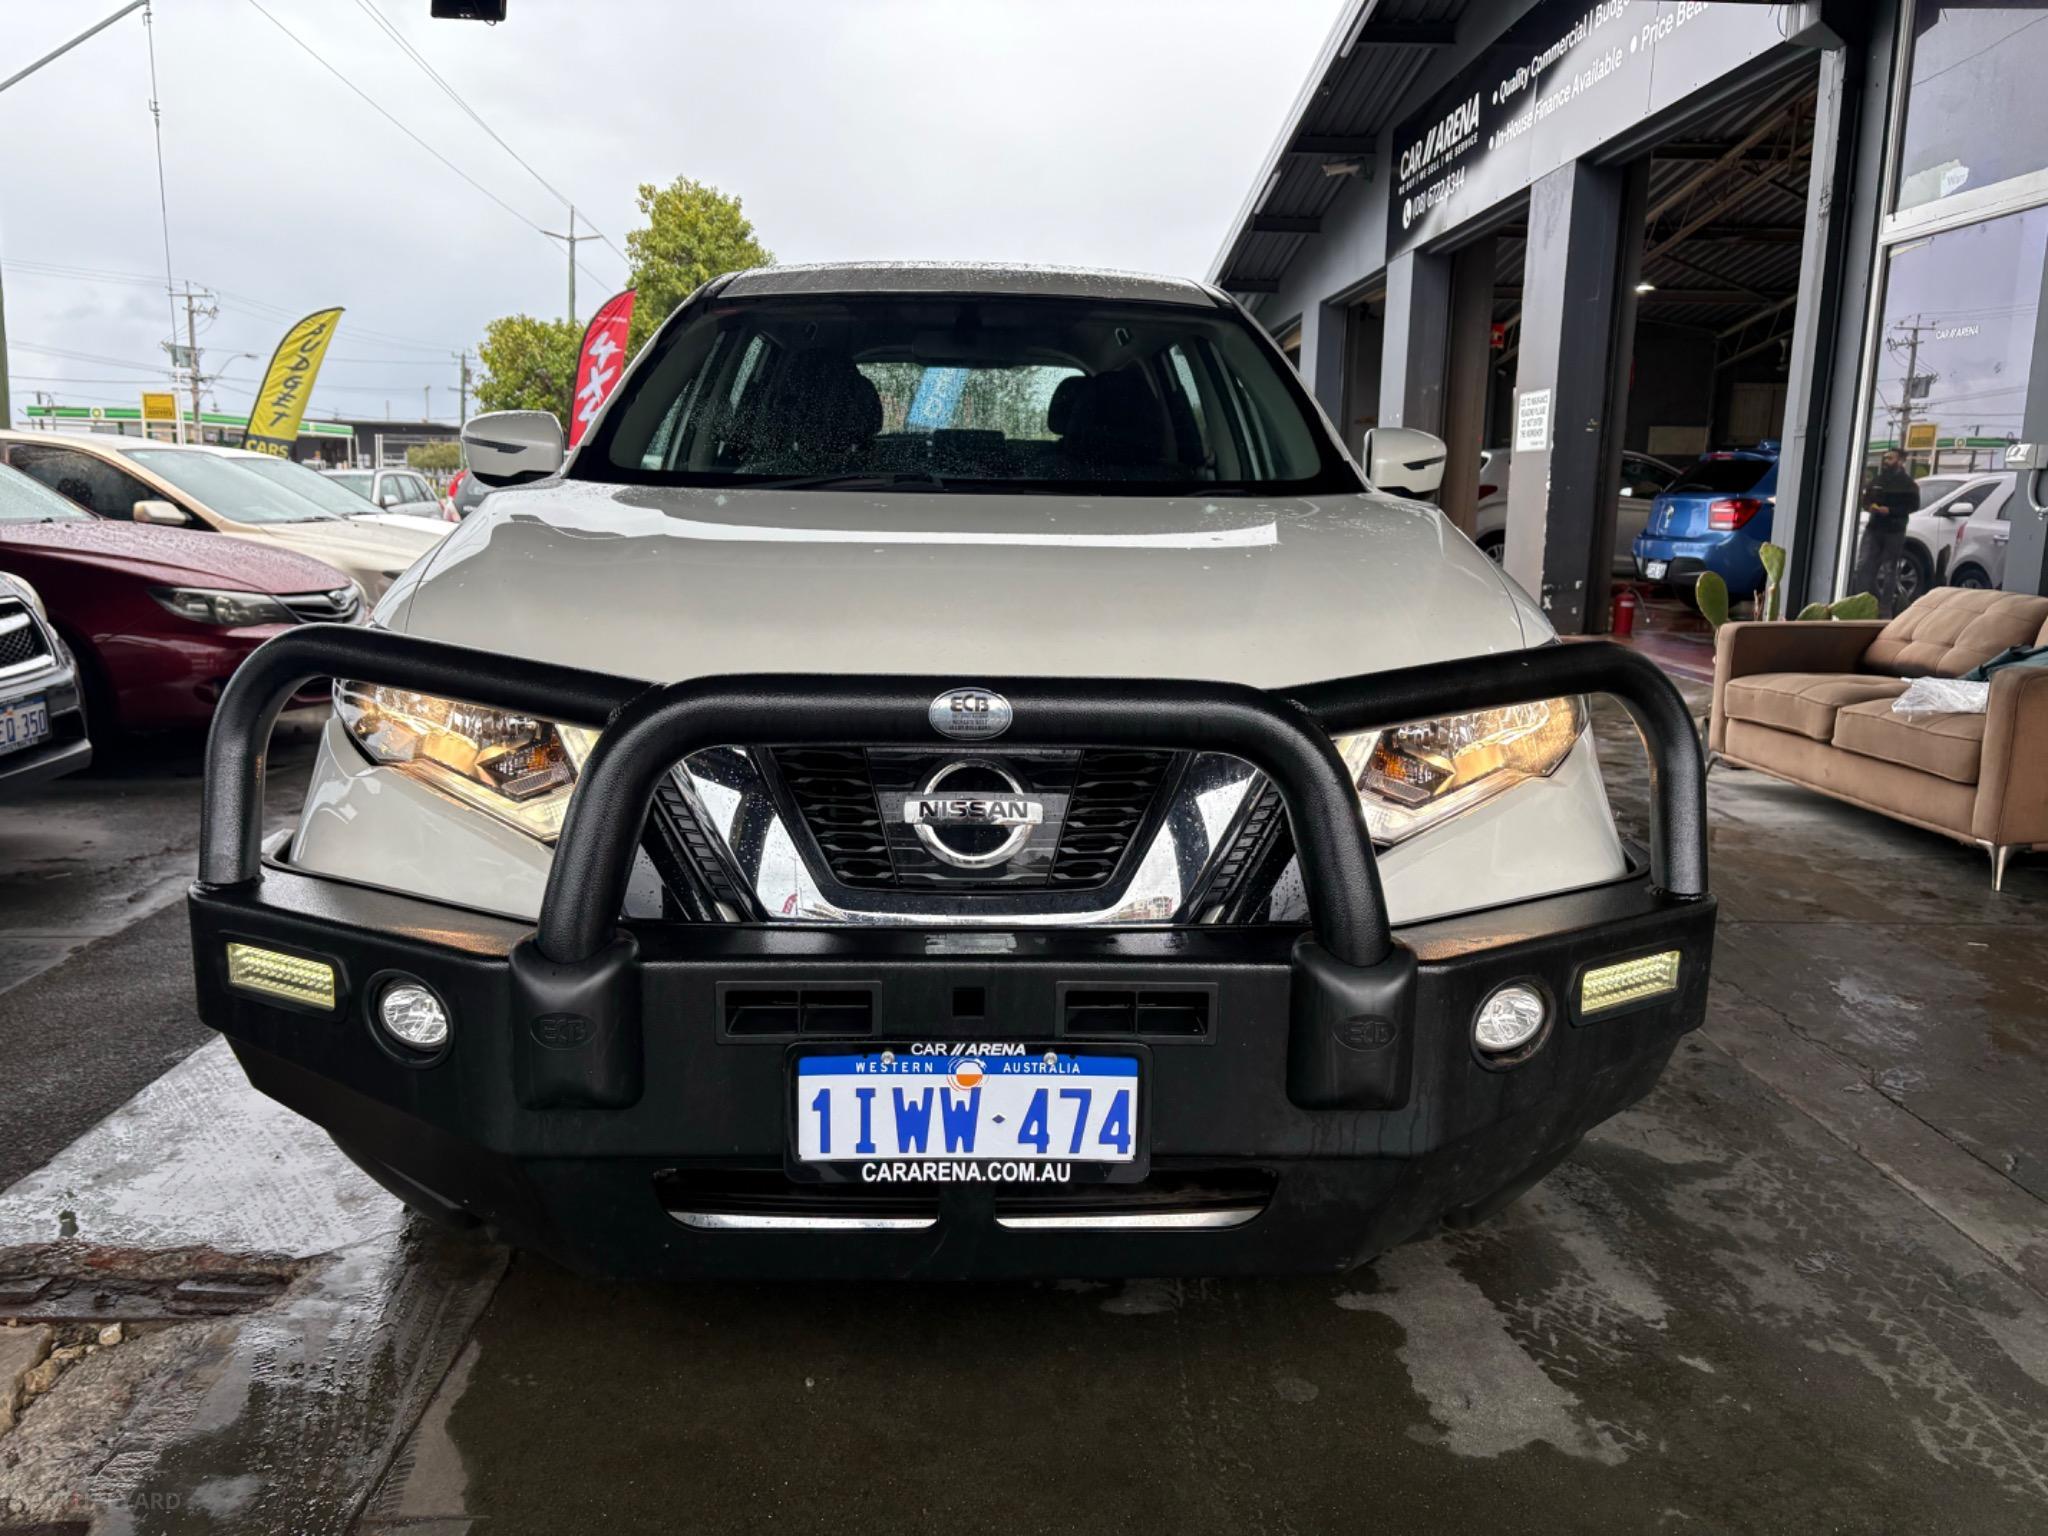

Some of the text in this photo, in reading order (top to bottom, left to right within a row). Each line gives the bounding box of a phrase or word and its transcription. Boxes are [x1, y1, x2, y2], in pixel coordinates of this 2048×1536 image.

[1500, 64, 1531, 104] Quality
[1531, 12, 1587, 76] Commercial
[1495, 111, 1532, 149] In-House
[1534, 82, 1570, 124] Finance
[1571, 47, 1623, 98] Available
[1641, 13, 1673, 51] Price
[270, 323, 326, 427] BUDGET
[245, 439, 289, 459] CARS
[950, 692, 989, 712] ECB
[21, 708, 48, 738] 350
[918, 799, 1029, 819] NISSAN
[911, 1043, 947, 1056] CAR
[855, 1061, 1081, 1075] WESTERN AUSTRALIA
[861, 1162, 1071, 1183] CARARENA.COM.AU
